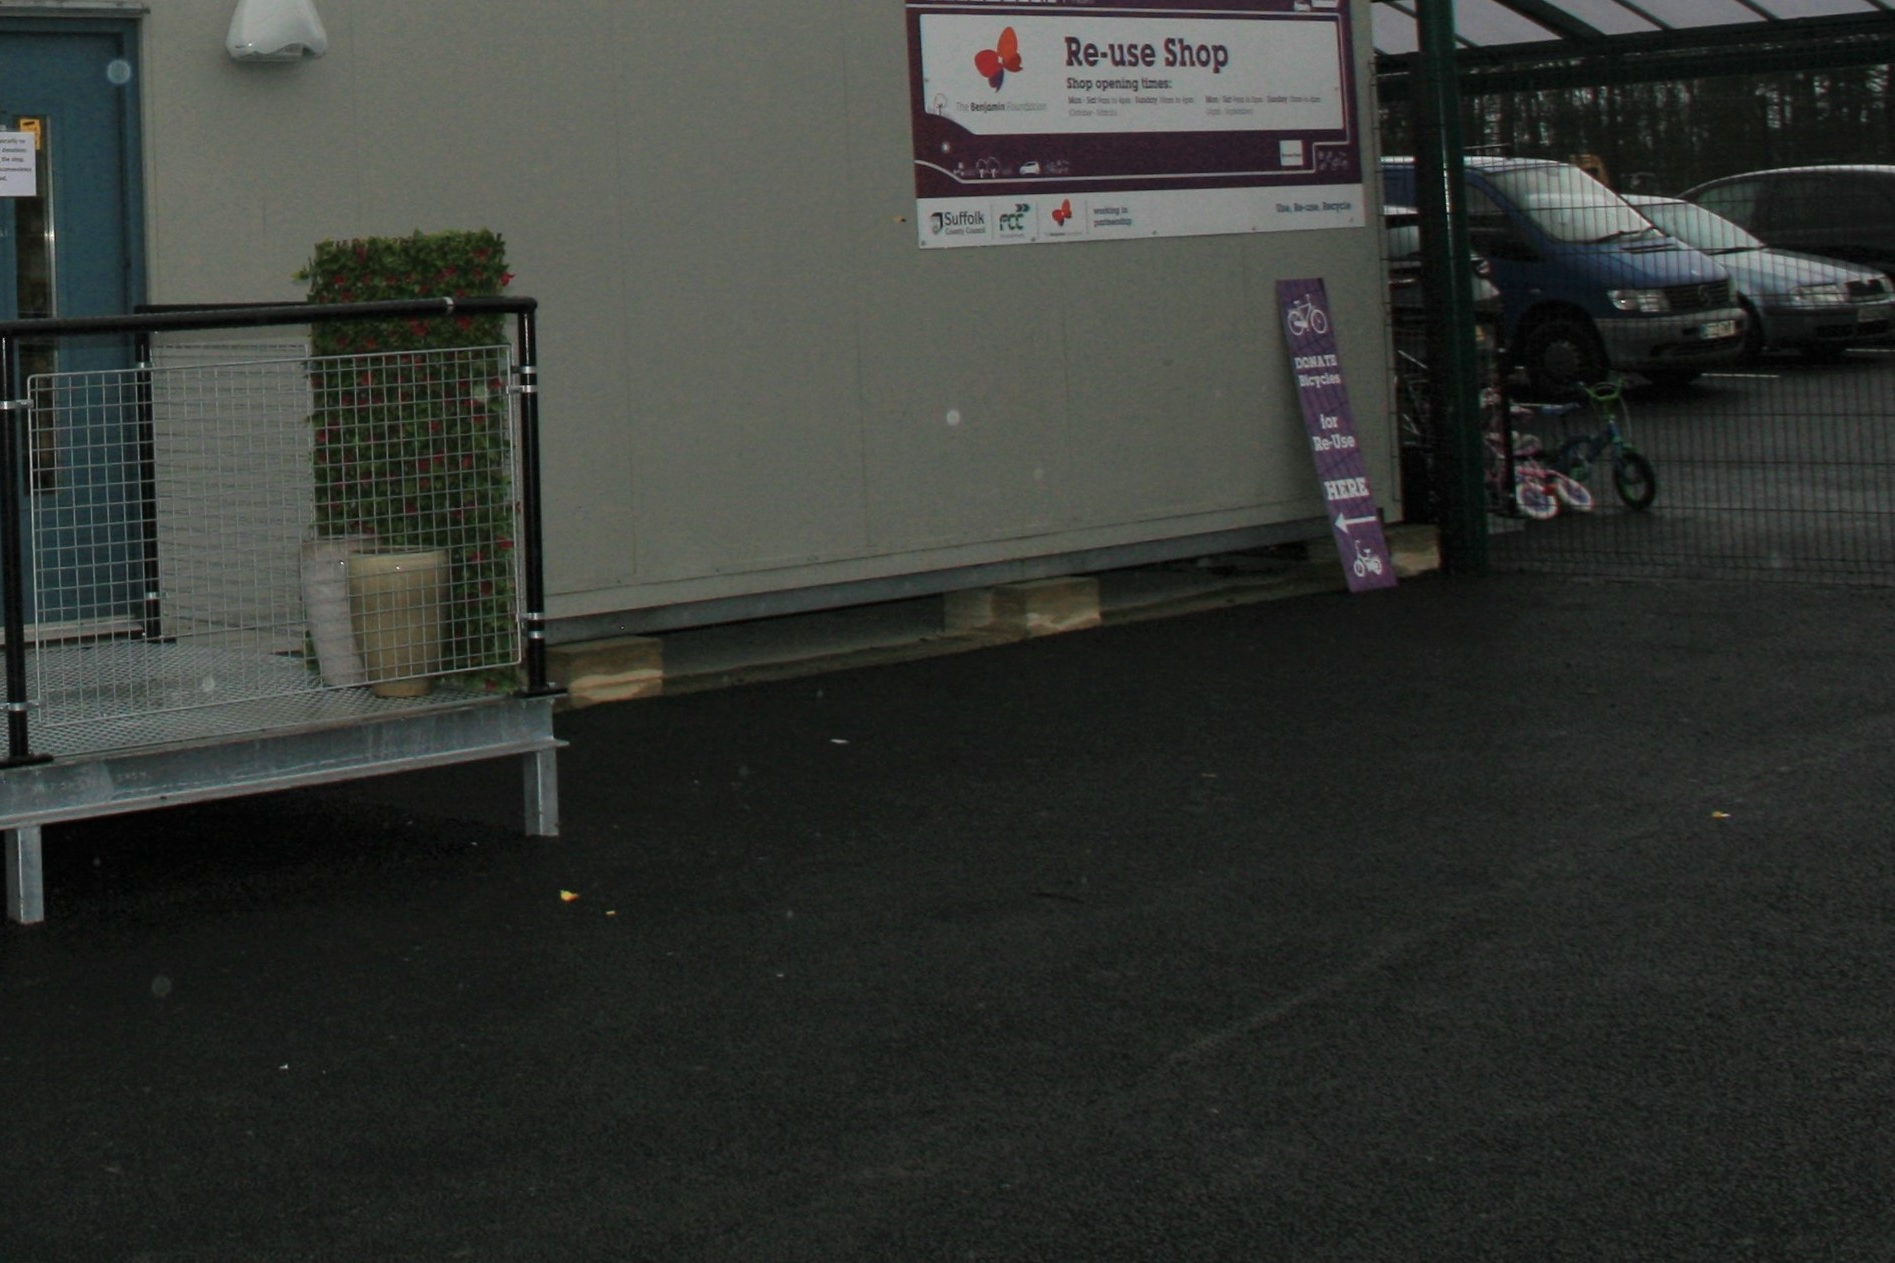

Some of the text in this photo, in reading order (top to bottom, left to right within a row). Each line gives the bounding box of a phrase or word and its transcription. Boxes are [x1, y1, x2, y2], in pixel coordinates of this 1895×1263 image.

[1064, 36, 1229, 74] Re-use Shop
[1066, 76, 1173, 92] Shop opening times:
[970, 102, 1005, 114] Benjamin
[945, 211, 985, 226] Suffolk
[999, 214, 1025, 231] FCC
[1294, 354, 1338, 369] DONATE
[1298, 373, 1341, 388] Bicycles
[1320, 414, 1338, 429] for
[1312, 434, 1356, 451] Re-Use
[1324, 477, 1370, 501] HERE
